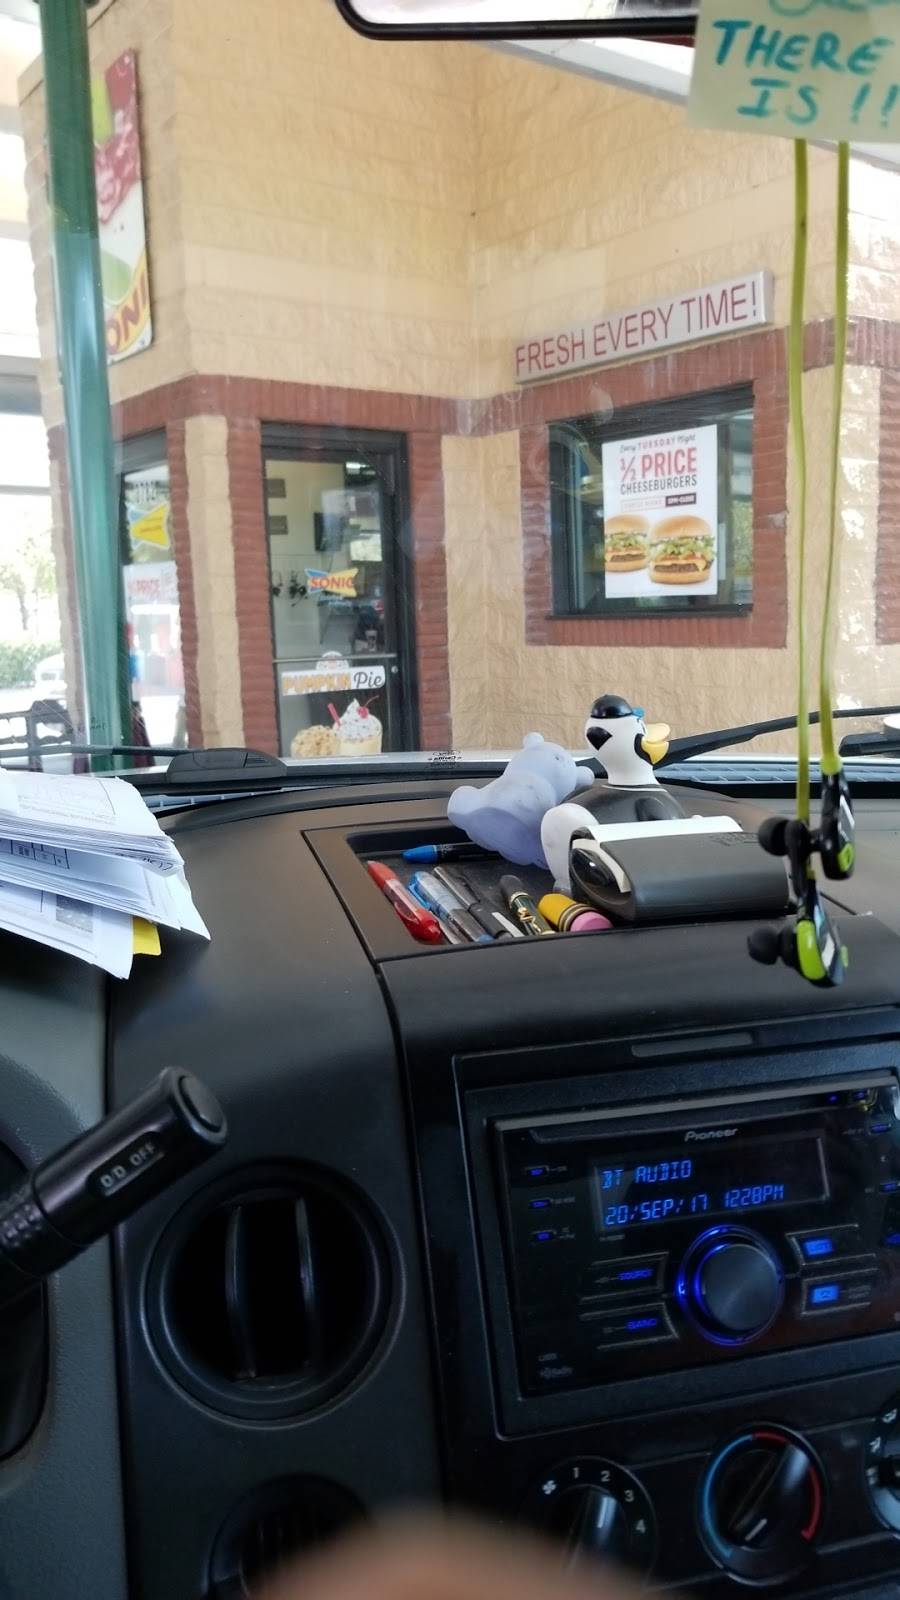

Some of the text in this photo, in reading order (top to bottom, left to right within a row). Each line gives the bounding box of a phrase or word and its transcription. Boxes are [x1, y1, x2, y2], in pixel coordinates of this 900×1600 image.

[713, 20, 895, 75] THERE
[736, 78, 820, 125] IS
[515, 281, 757, 377] FRESH EVERY TIME!
[638, 436, 676, 449] TUESDAY
[641, 447, 697, 479] PRICE
[620, 474, 697, 496] CHEESEBURGERS
[310, 576, 354, 590] SONIC
[353, 671, 383, 688] Pie
[684, 1128, 739, 1142] Pioneer
[130, 1142, 155, 1166] OFF
[602, 1160, 692, 1189] BT AUDIO
[573, 1467, 646, 1534] 1 2 3 4
